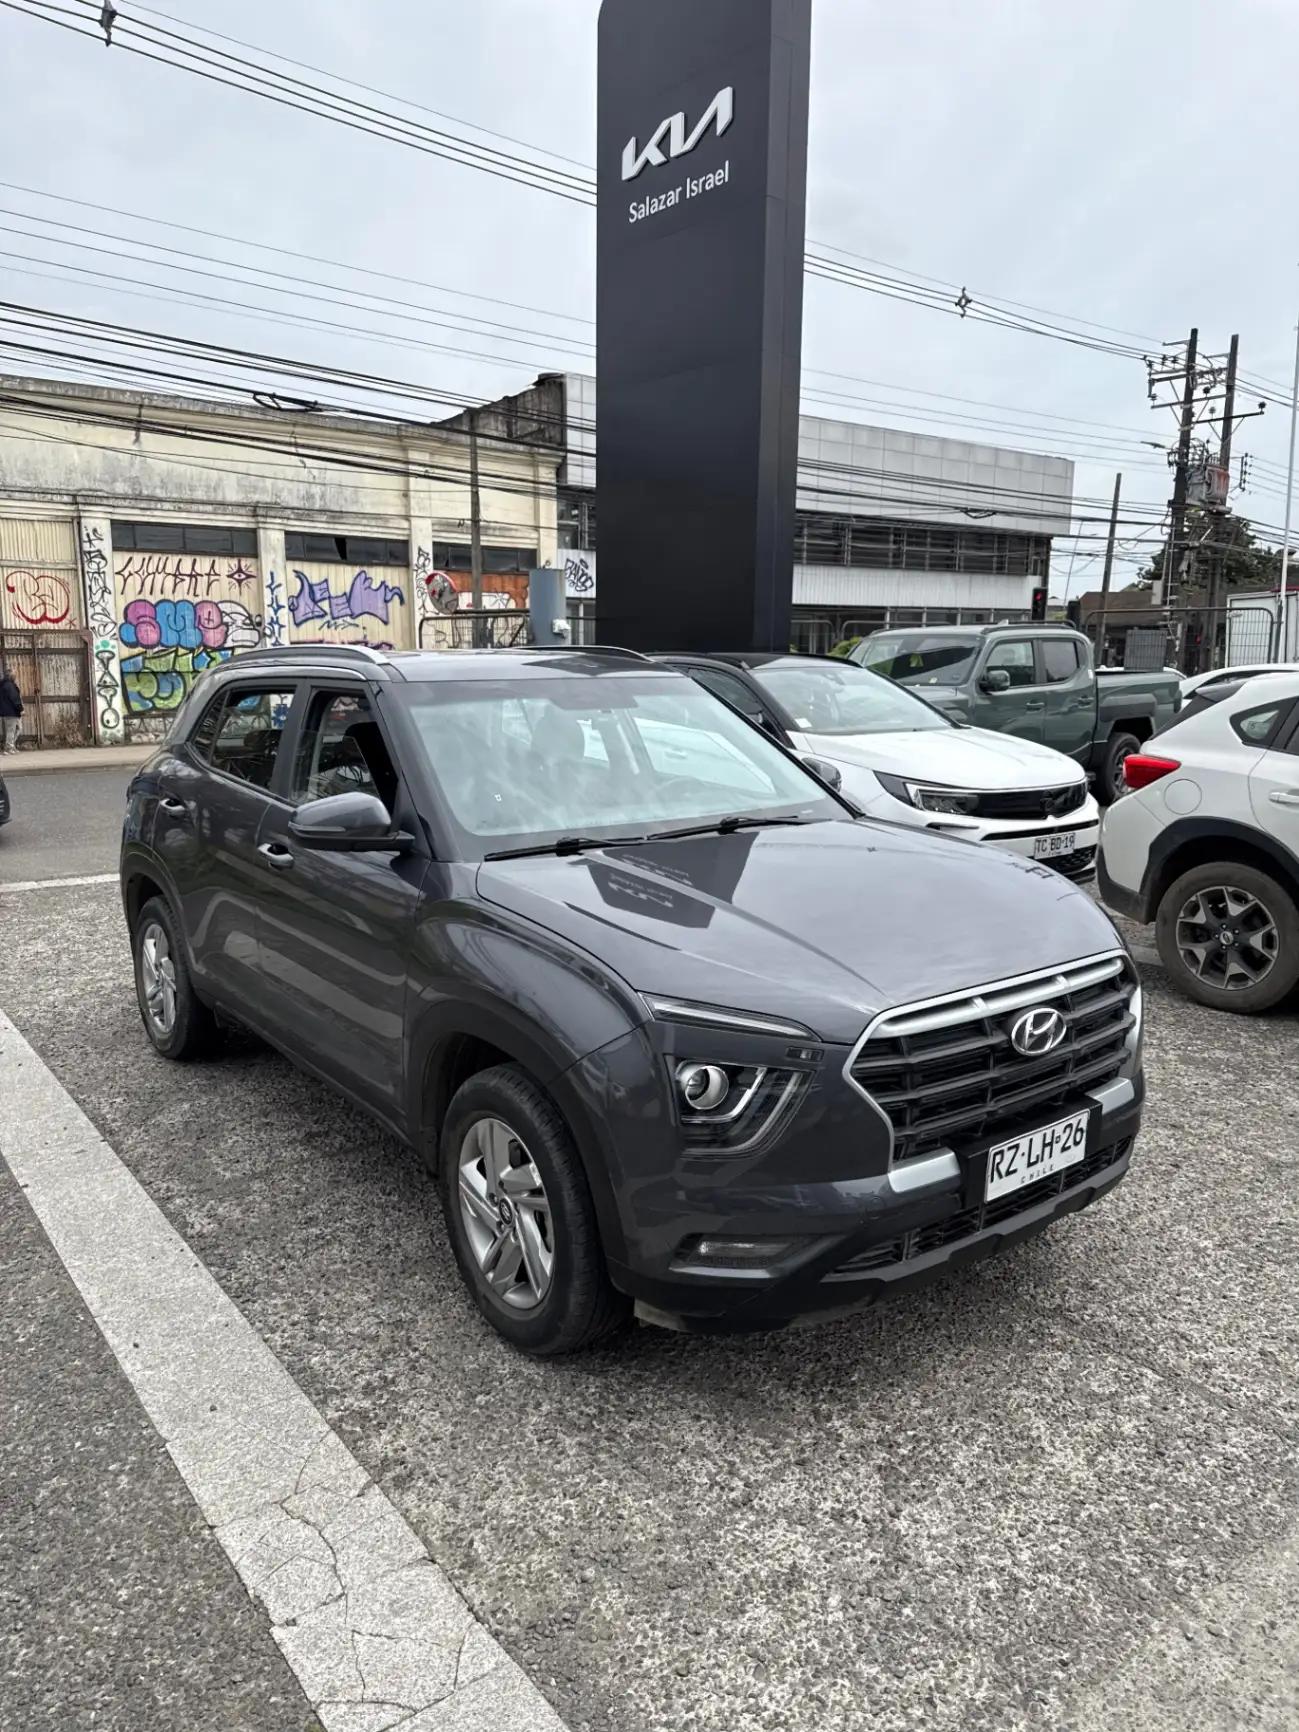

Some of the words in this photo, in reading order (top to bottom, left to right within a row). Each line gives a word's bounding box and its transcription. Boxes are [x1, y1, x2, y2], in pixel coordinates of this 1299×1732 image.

[621, 86, 734, 182] KIA
[628, 186, 682, 223] Salazar
[686, 160, 730, 199] Israel
